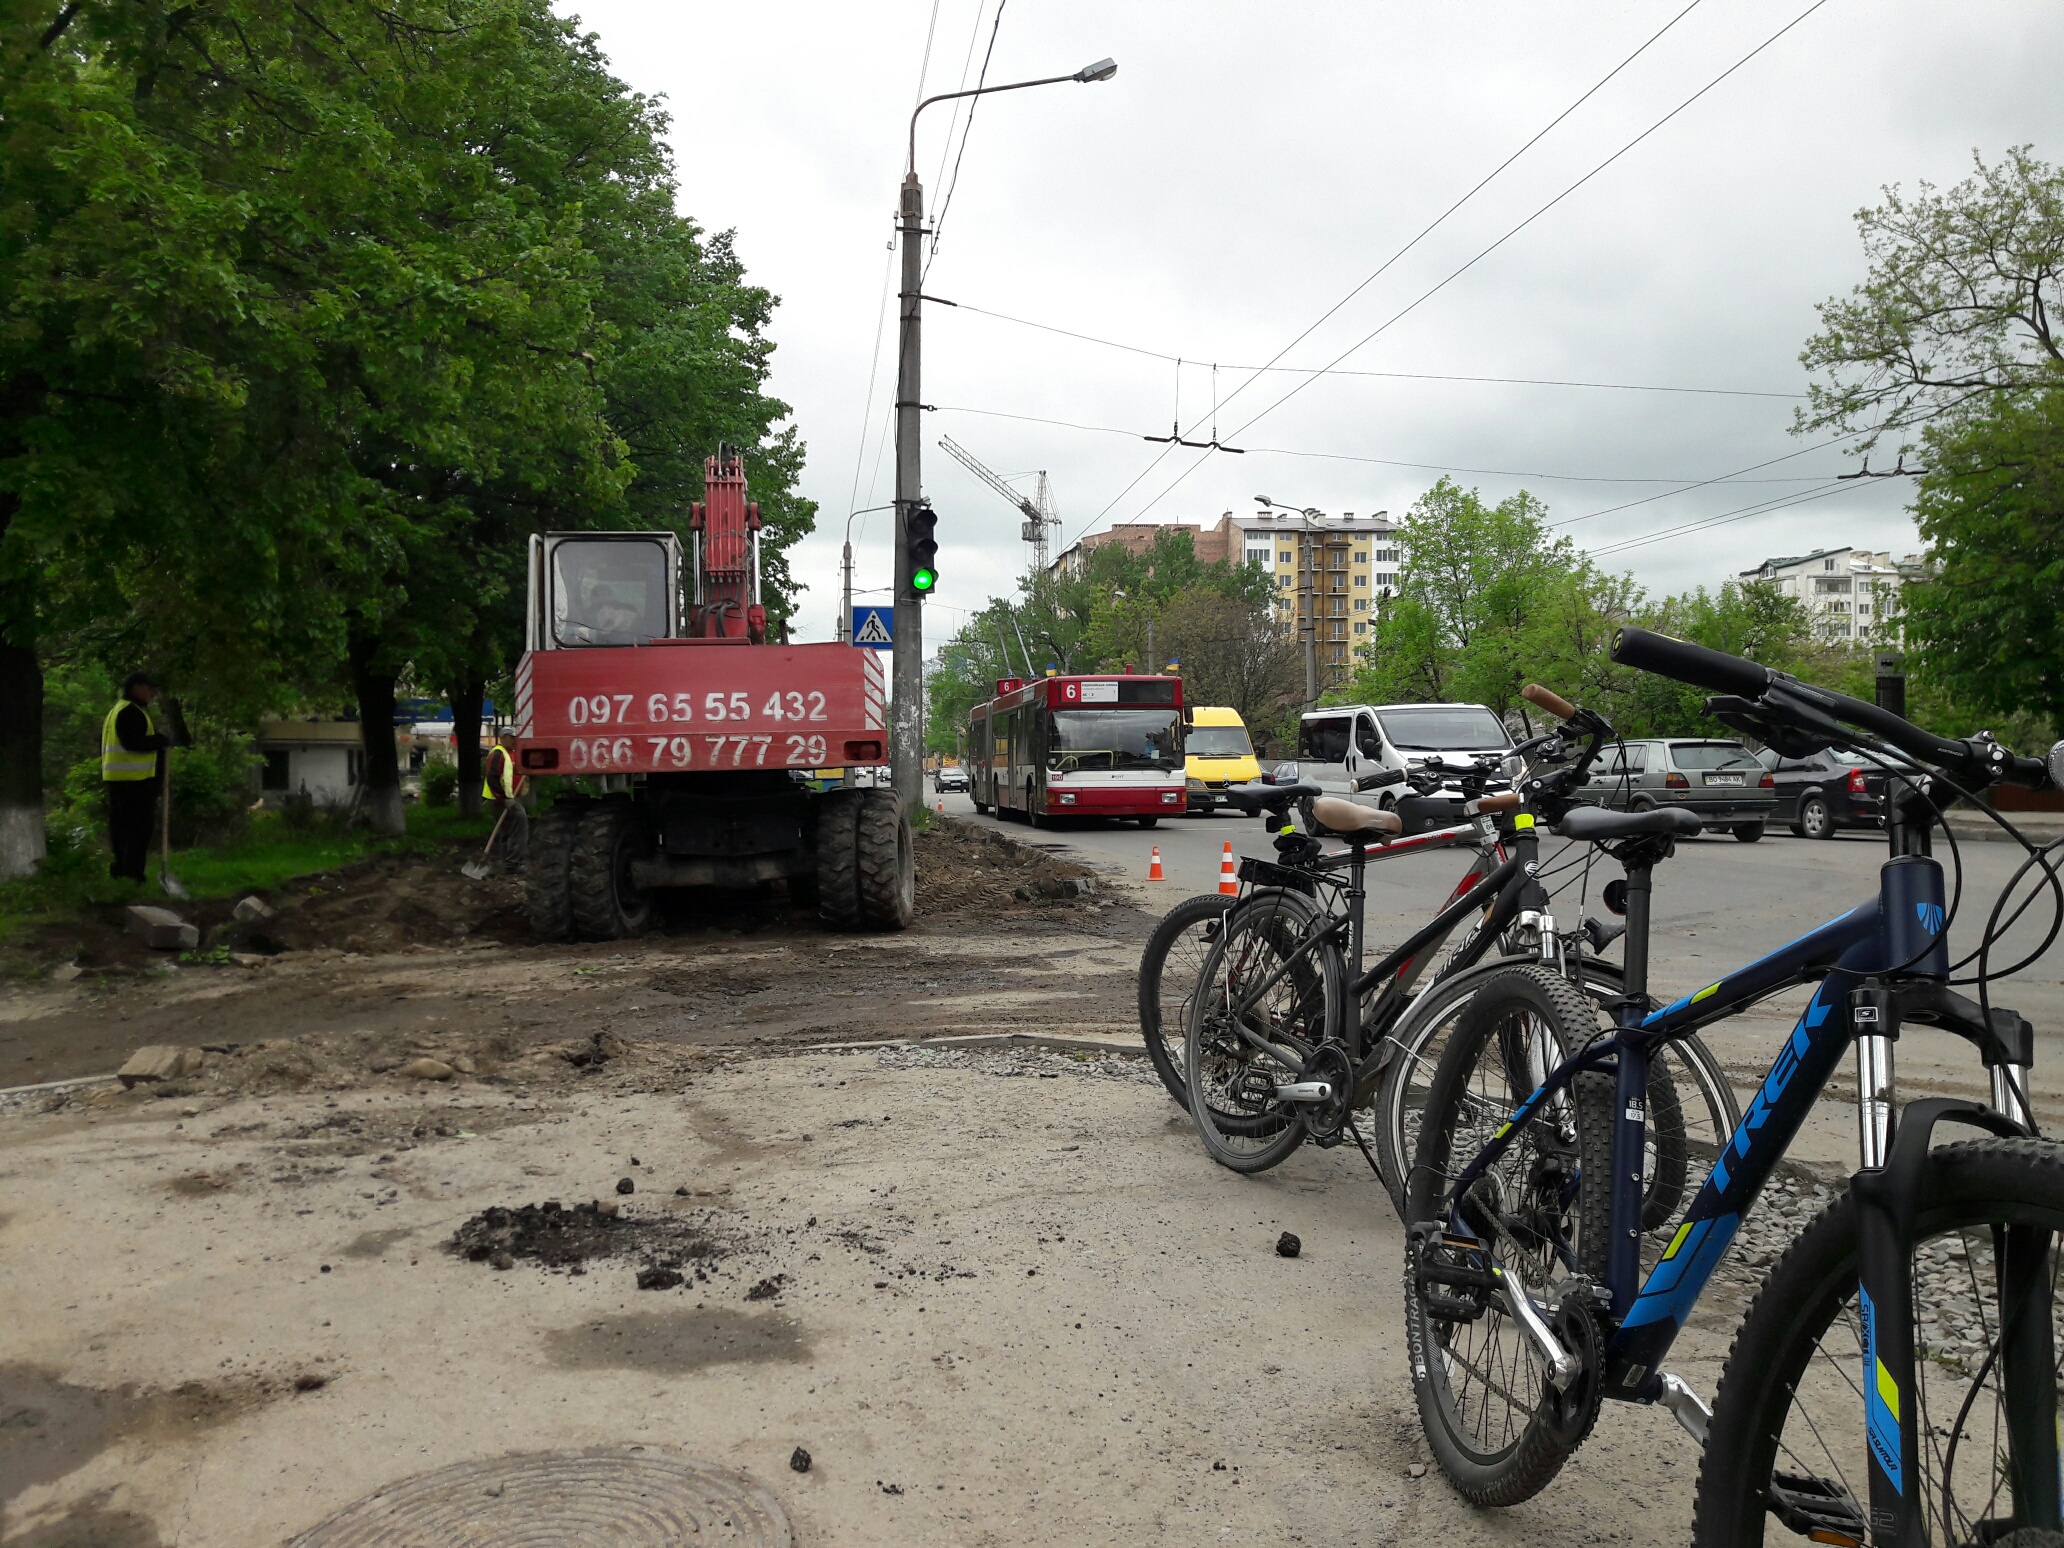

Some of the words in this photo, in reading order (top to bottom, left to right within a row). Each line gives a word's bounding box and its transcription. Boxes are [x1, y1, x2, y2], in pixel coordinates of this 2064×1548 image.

[1004, 682, 1009, 691] 6
[1066, 684, 1076, 698] 6
[568, 694, 634, 726] 097
[647, 693, 692, 722] 65
[704, 692, 751, 720] 55
[762, 691, 828, 721] 432
[570, 737, 633, 769] 066
[647, 737, 692, 768] 79
[704, 736, 773, 766] 777
[785, 735, 827, 765] 29
[1703, 978, 1833, 1194] TREK
[1628, 1099, 1643, 1109] 18.5
